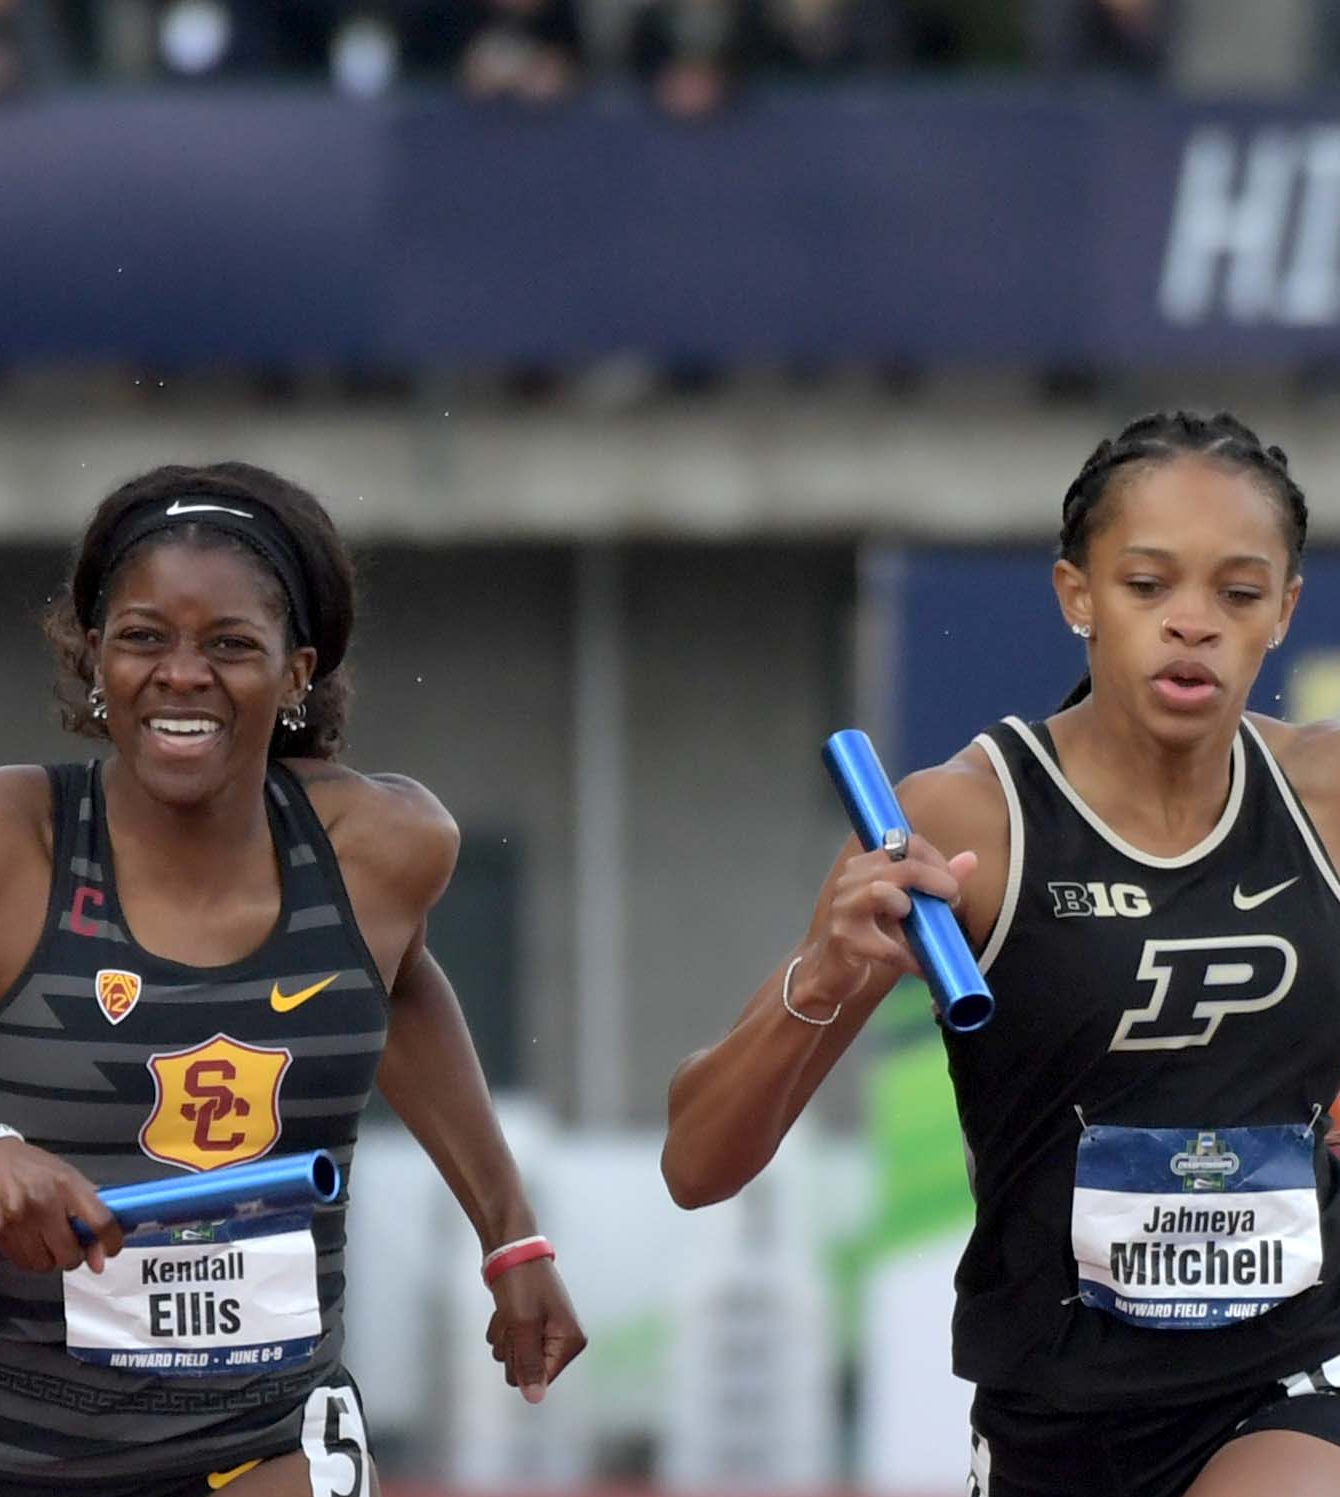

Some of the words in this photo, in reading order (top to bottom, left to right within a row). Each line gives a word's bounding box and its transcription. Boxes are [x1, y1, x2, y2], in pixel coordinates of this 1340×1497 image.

[69, 886, 104, 936] C
[100, 974, 138, 1002] PAC
[106, 992, 127, 1012] 12
[1108, 934, 1298, 1052] P
[1144, 1206, 1255, 1236] Jahneya
[142, 1252, 244, 1284] Kendall
[1110, 1239, 1283, 1286] Mitchell
[149, 1292, 241, 1337] Ellis
[1174, 1303, 1207, 1318] FIELD
[110, 1353, 174, 1367] HAYWARD
[174, 1353, 208, 1367] FIELD
[226, 1349, 258, 1365] JUNE
[261, 1347, 283, 1362] 6-9
